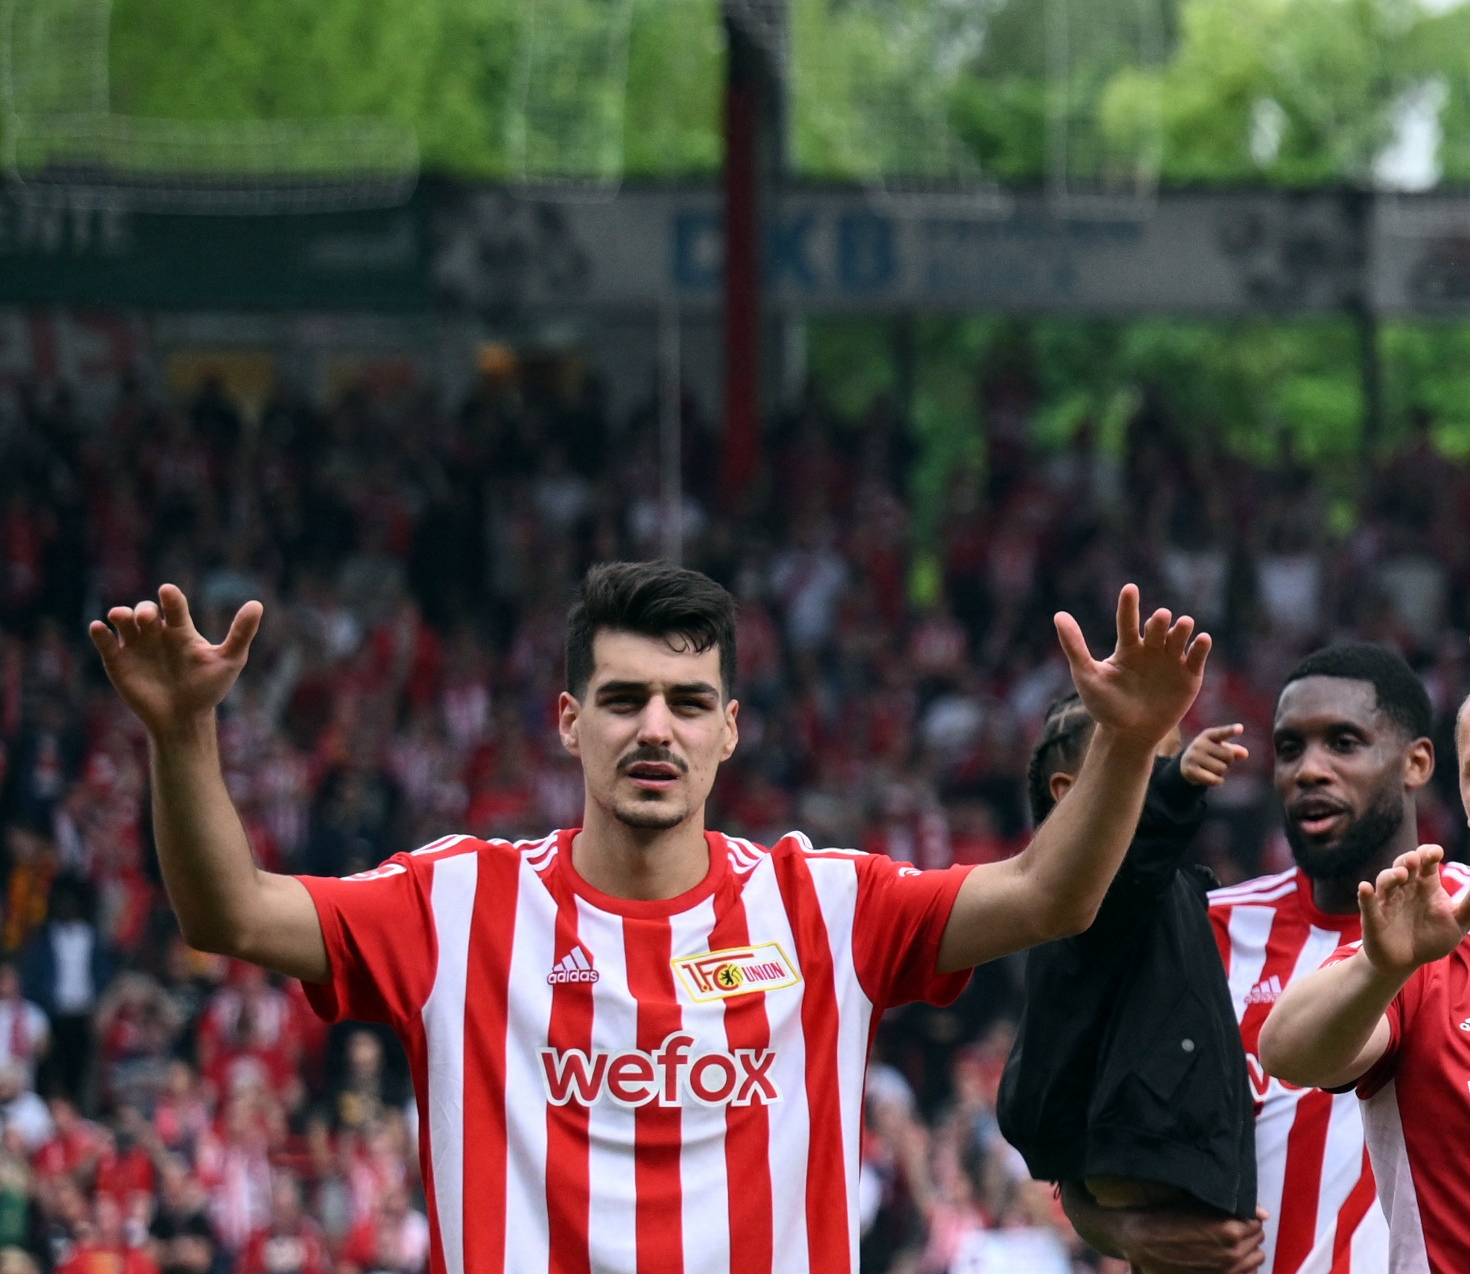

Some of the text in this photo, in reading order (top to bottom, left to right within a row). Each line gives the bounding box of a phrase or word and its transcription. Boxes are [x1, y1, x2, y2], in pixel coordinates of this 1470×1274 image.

[547, 967, 599, 985] adidas
[743, 959, 787, 985] UNION
[540, 1031, 783, 1107] wefox
